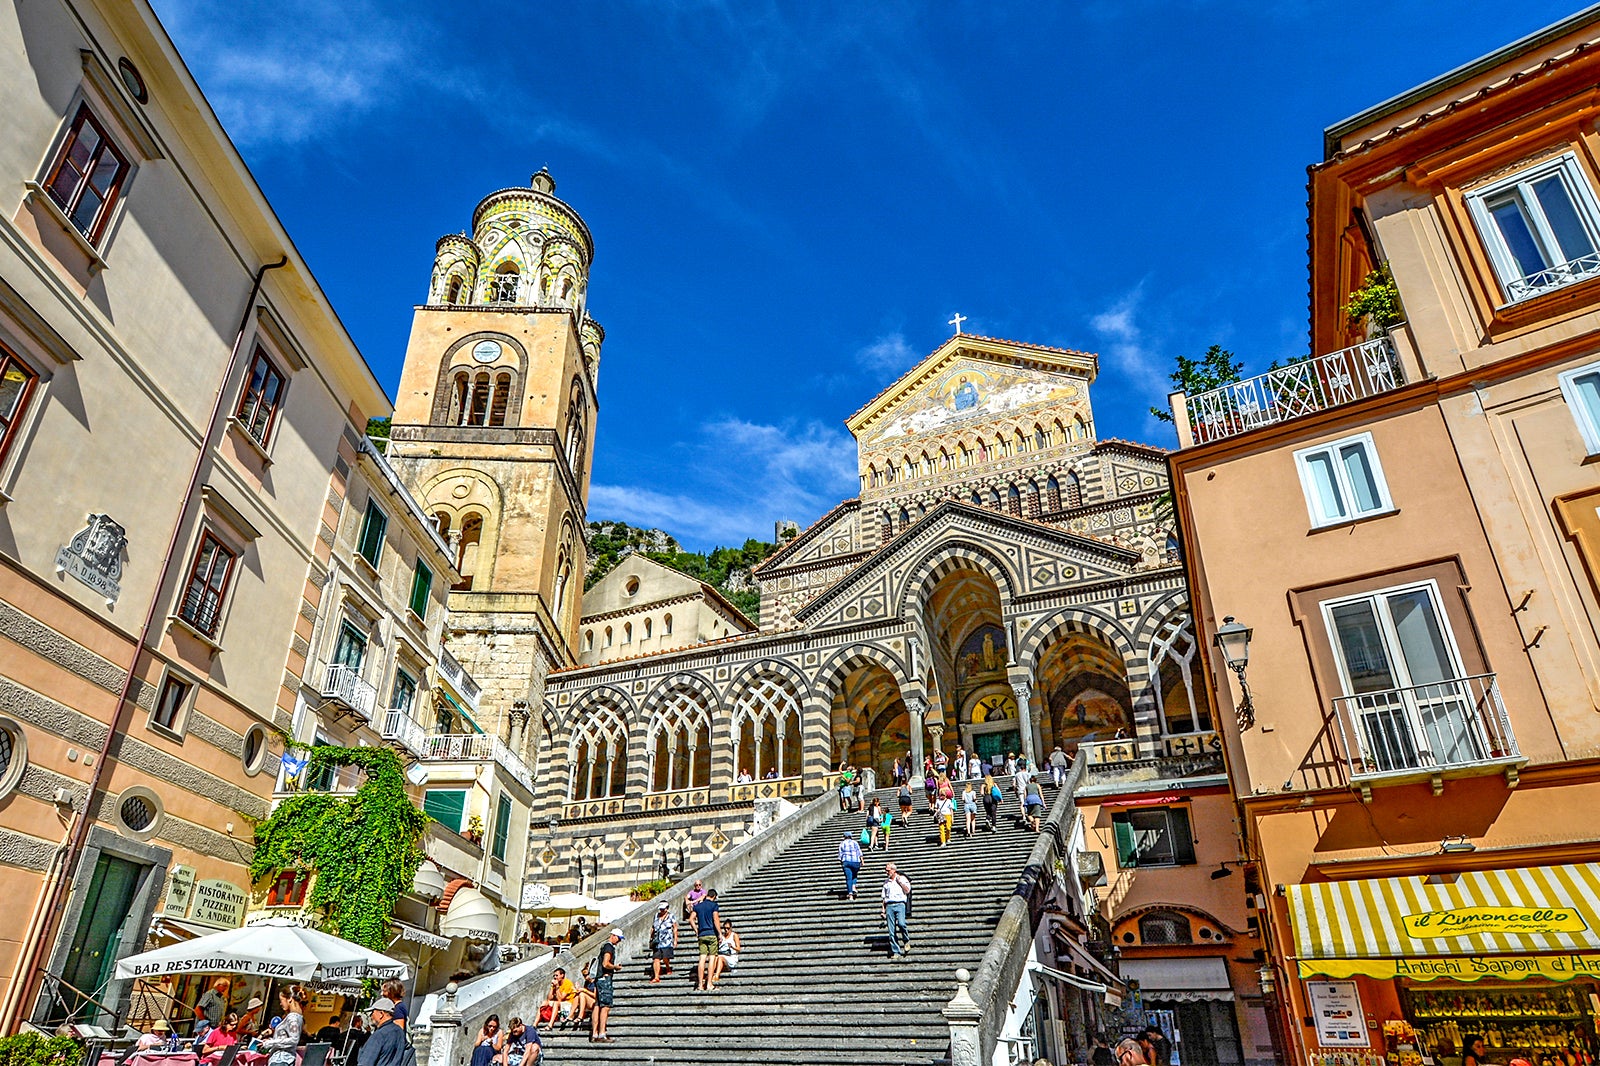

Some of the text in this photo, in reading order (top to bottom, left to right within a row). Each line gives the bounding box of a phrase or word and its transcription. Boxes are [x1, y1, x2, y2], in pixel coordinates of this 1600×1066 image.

[80, 567, 88, 577] D
[88, 573, 106, 590] 1898
[198, 885, 244, 905] RISTORANTE
[166, 903, 185, 913] COFFEE
[202, 898, 236, 914] PIZZERIA
[195, 908, 204, 918] S.
[206, 911, 236, 925] ANDREA
[1413, 909, 1569, 928] il Limoncello
[134, 958, 294, 977] BAR RESTAURANT PIZZA
[326, 966, 352, 979] LIGHT
[1395, 958, 1462, 974] Antichi
[1470, 955, 1541, 975] Sapori
